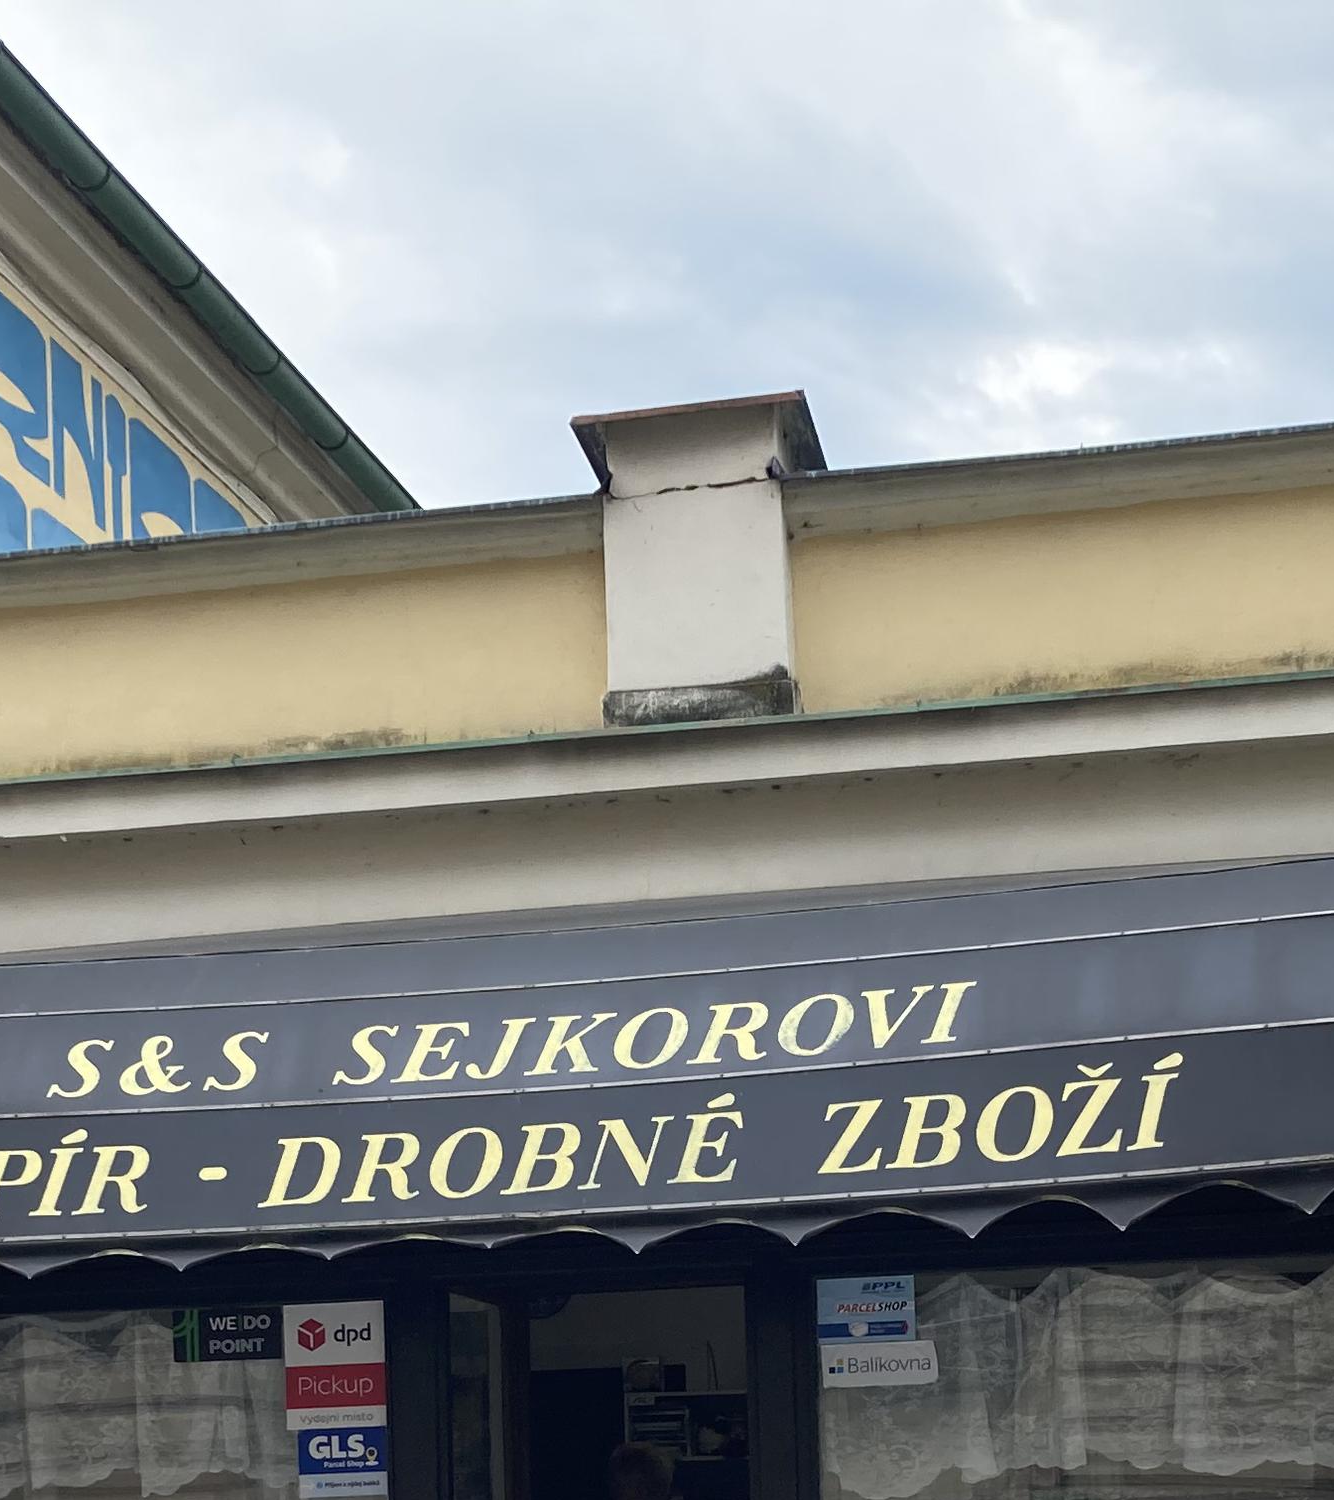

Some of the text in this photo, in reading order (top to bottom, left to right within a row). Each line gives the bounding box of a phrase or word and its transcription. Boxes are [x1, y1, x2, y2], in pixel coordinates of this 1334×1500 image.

[46, 980, 978, 1098] S&S SEJKOROVI
[198, 1165, 228, 1181] -
[257, 1092, 746, 1209] DROBNÉ
[817, 1052, 1185, 1175] ZBOŽÍ
[870, 1281, 905, 1290] PPL
[209, 1314, 272, 1332] WE DO
[333, 1322, 372, 1347] dpd
[209, 1337, 265, 1354] POINT
[847, 1356, 931, 1374] Balíkovna
[298, 1375, 374, 1398] Pickup
[308, 1433, 366, 1460] GLS
